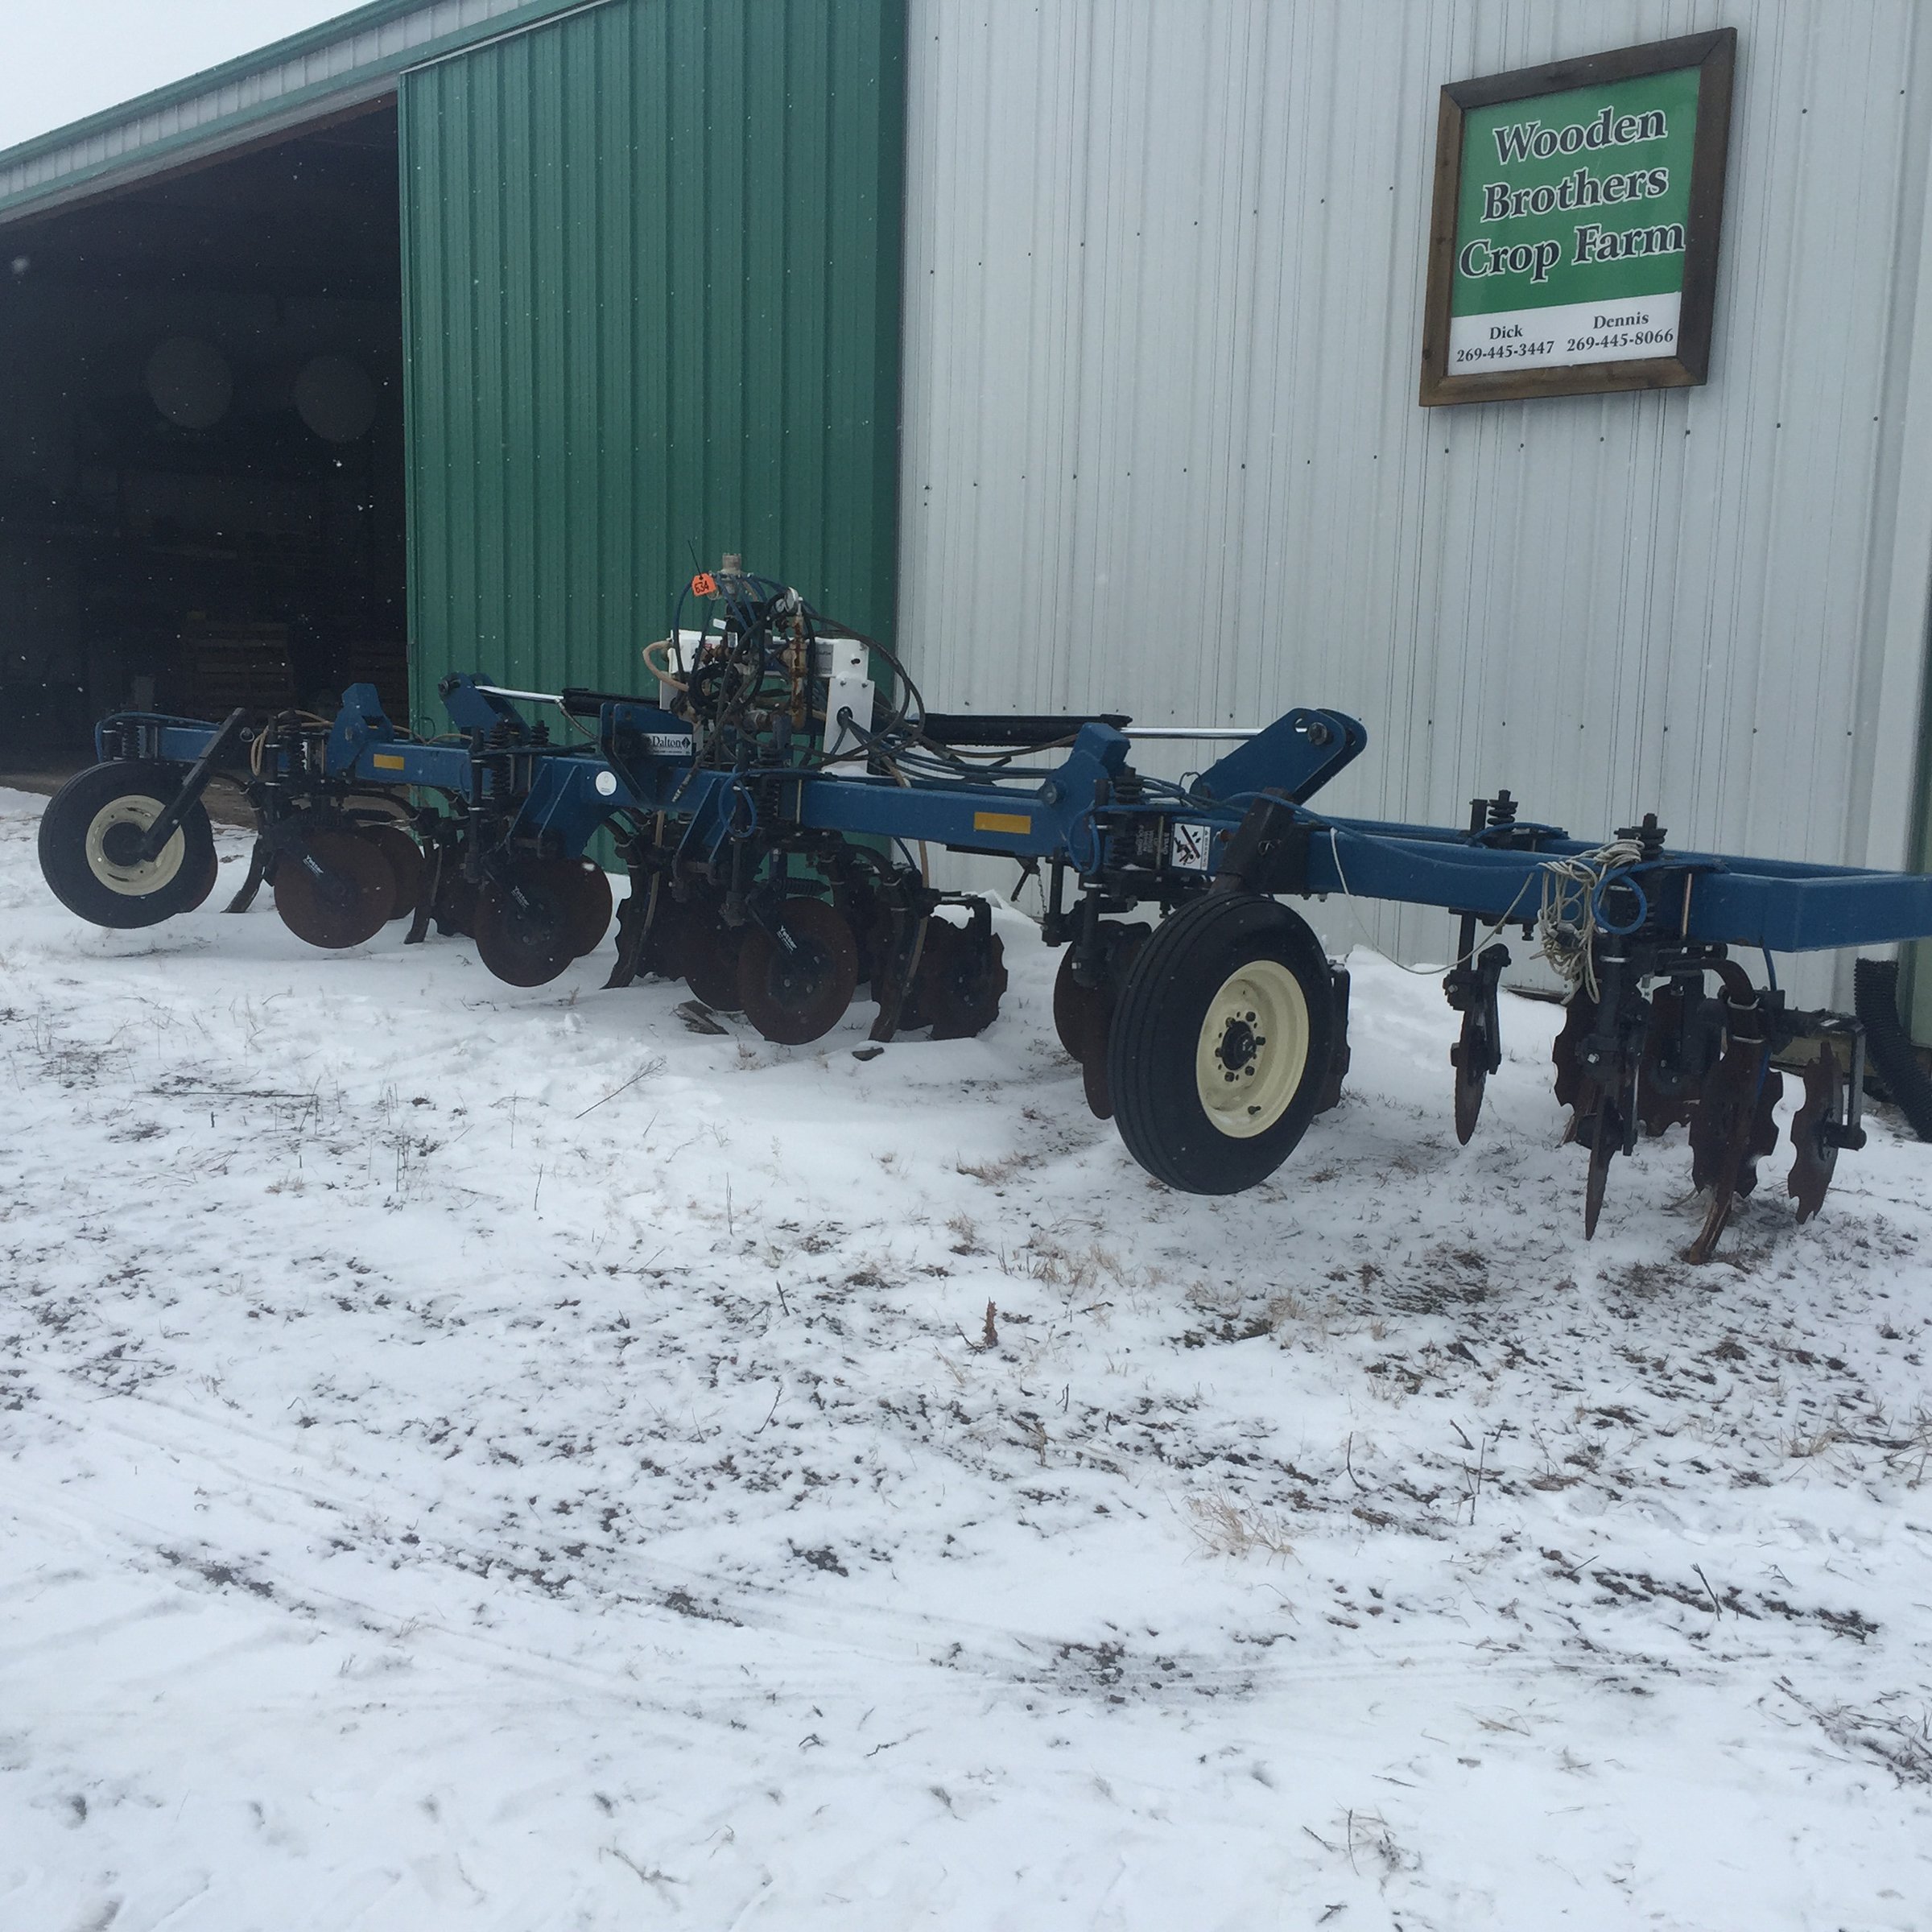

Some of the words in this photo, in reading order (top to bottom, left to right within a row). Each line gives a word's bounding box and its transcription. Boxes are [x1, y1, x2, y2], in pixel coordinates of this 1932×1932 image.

[1492, 105, 1668, 165] Wooden
[1480, 167, 1669, 222] Brothers
[1459, 238, 1561, 283] Crop
[1571, 223, 1686, 266] Farm
[1593, 312, 1649, 329] Dennis
[1489, 324, 1523, 341] Dick
[1567, 328, 1674, 352] 269-445-8066
[1457, 341, 1554, 362] 269-445-3447
[652, 736, 682, 749] Dalton
